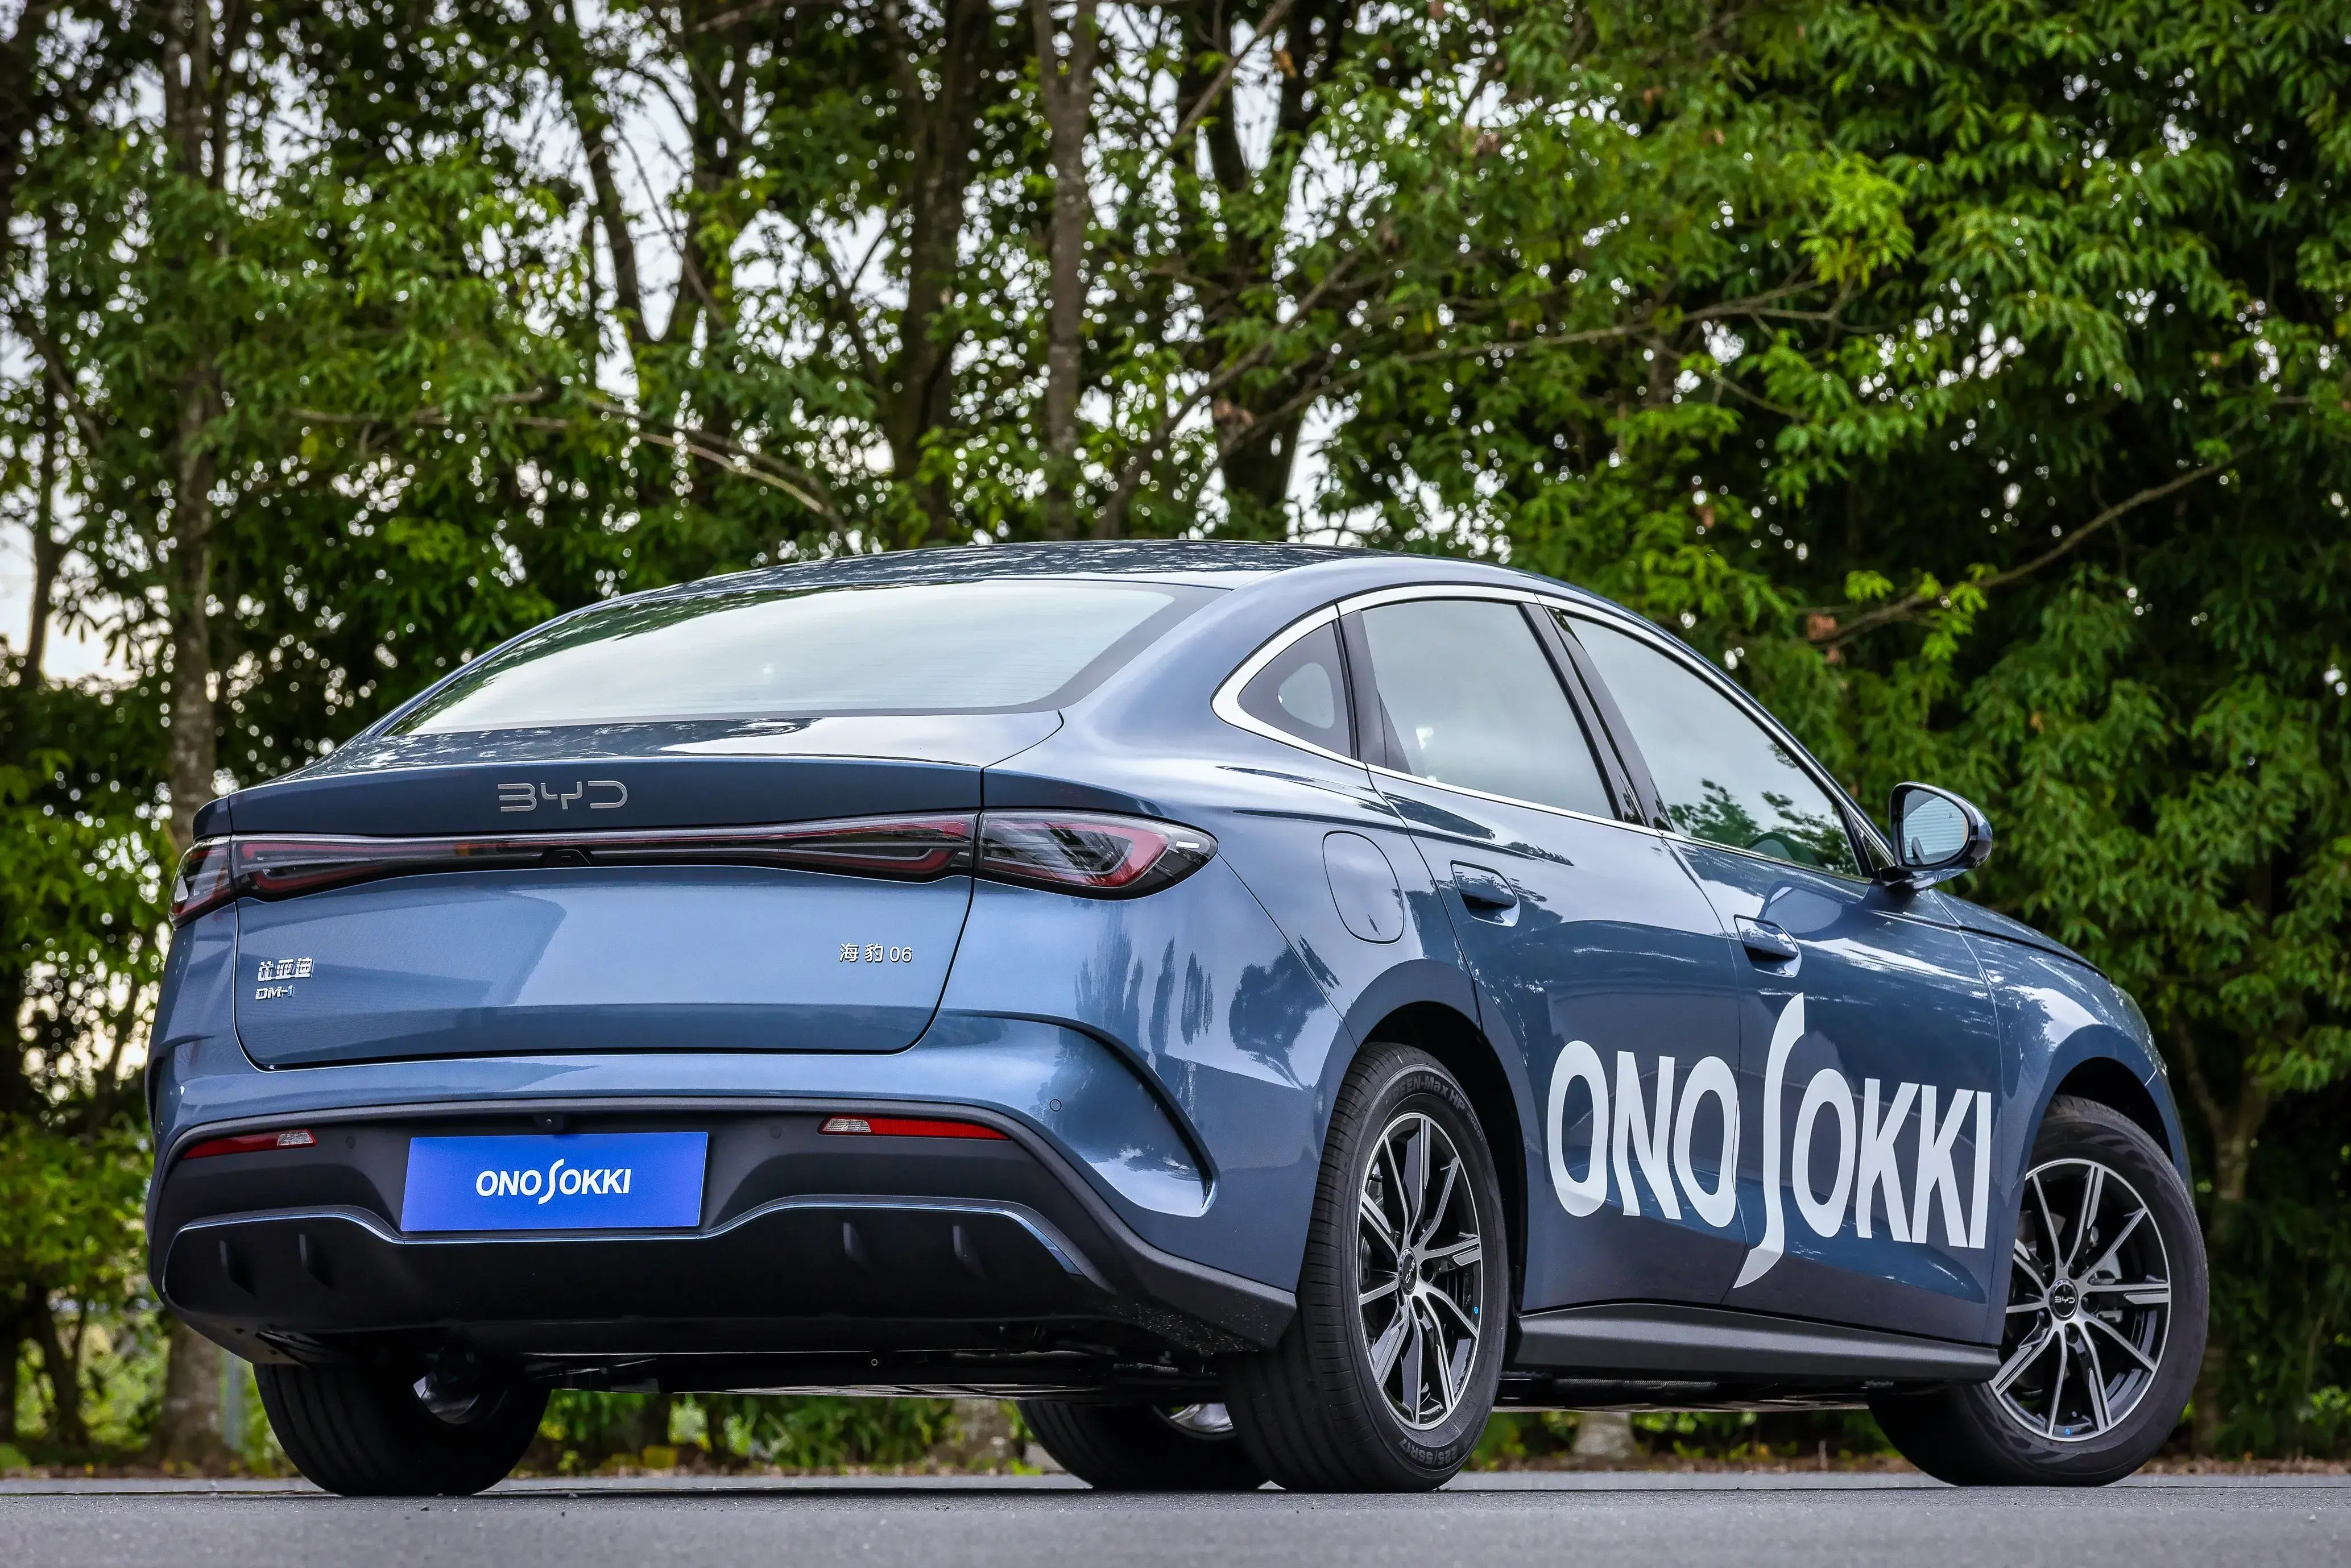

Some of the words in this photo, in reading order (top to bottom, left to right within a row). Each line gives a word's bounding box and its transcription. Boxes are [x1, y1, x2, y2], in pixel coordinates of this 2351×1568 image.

[498, 780, 628, 812] BYD
[839, 943, 884, 963] 海豹
[889, 946, 913, 963] 06
[258, 957, 313, 982] 比亚迪
[1405, 1259, 1415, 1284] BYD
[1398, 1438, 1458, 1466] 225/55R17
